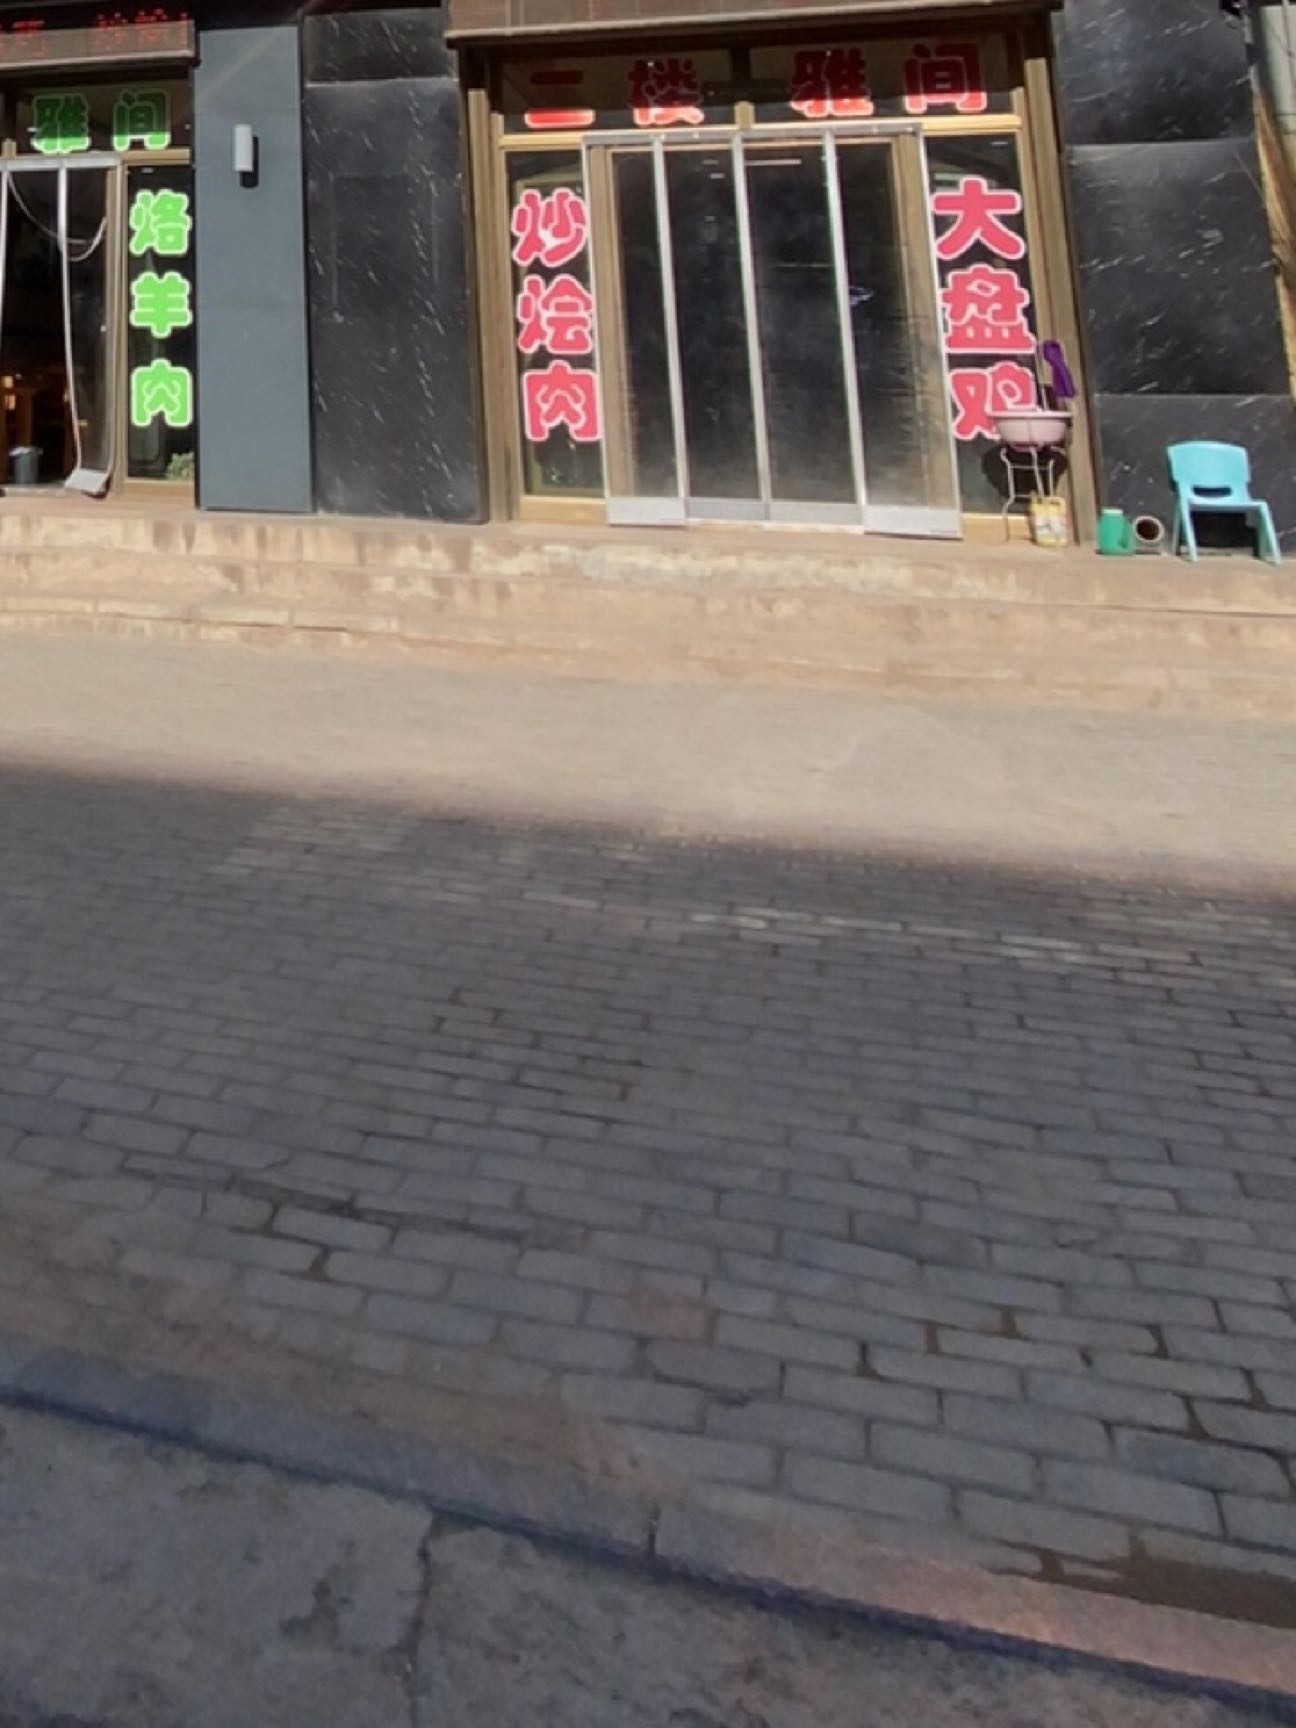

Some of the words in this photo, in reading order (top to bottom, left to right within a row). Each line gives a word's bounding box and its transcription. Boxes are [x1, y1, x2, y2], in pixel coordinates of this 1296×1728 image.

[511, 186, 601, 442] 炒烩肉
[932, 177, 1037, 440] 大盘鸡
